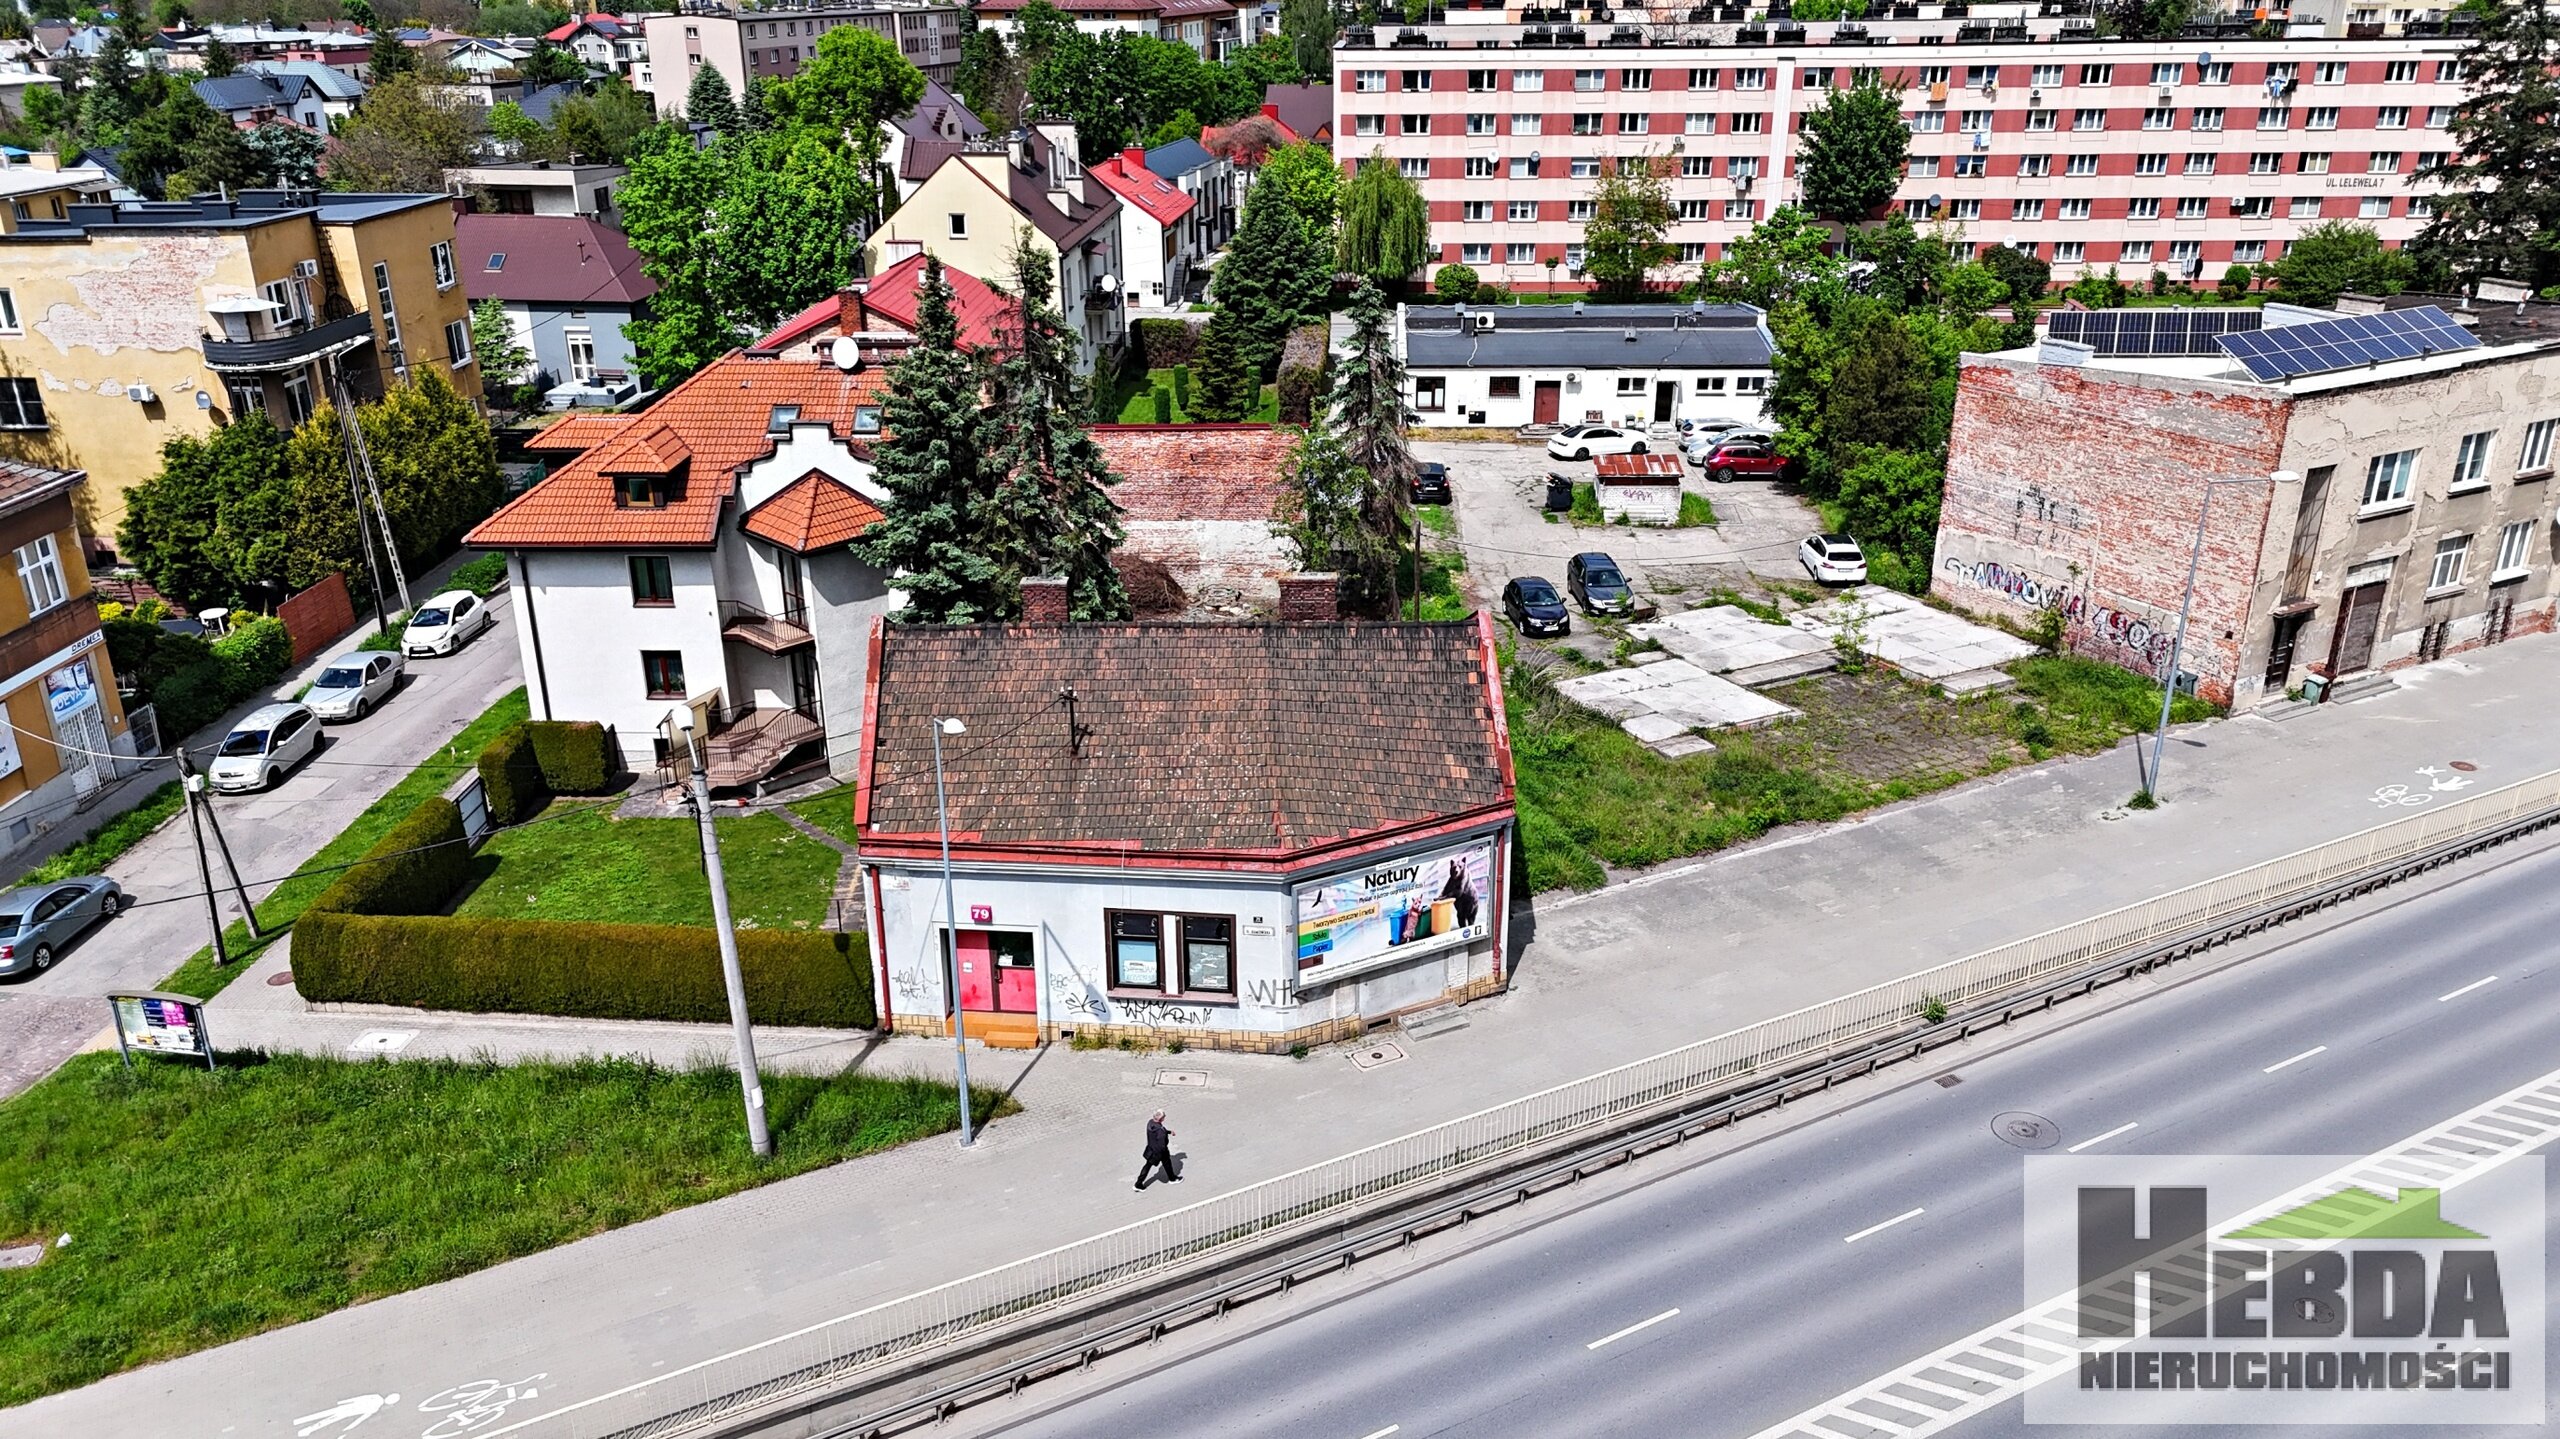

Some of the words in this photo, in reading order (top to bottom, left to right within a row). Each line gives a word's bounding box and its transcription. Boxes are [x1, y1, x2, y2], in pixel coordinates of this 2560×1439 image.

[2326, 178, 2337, 188] UL.
[2339, 178, 2377, 188] LELEWELA
[2379, 178, 2385, 188] 7
[72, 632, 100, 652] DREMEX
[57, 689, 83, 709] DEVA
[1365, 865, 1420, 889] Natury
[972, 908, 990, 919] 79
[1312, 943, 1329, 953] Papier
